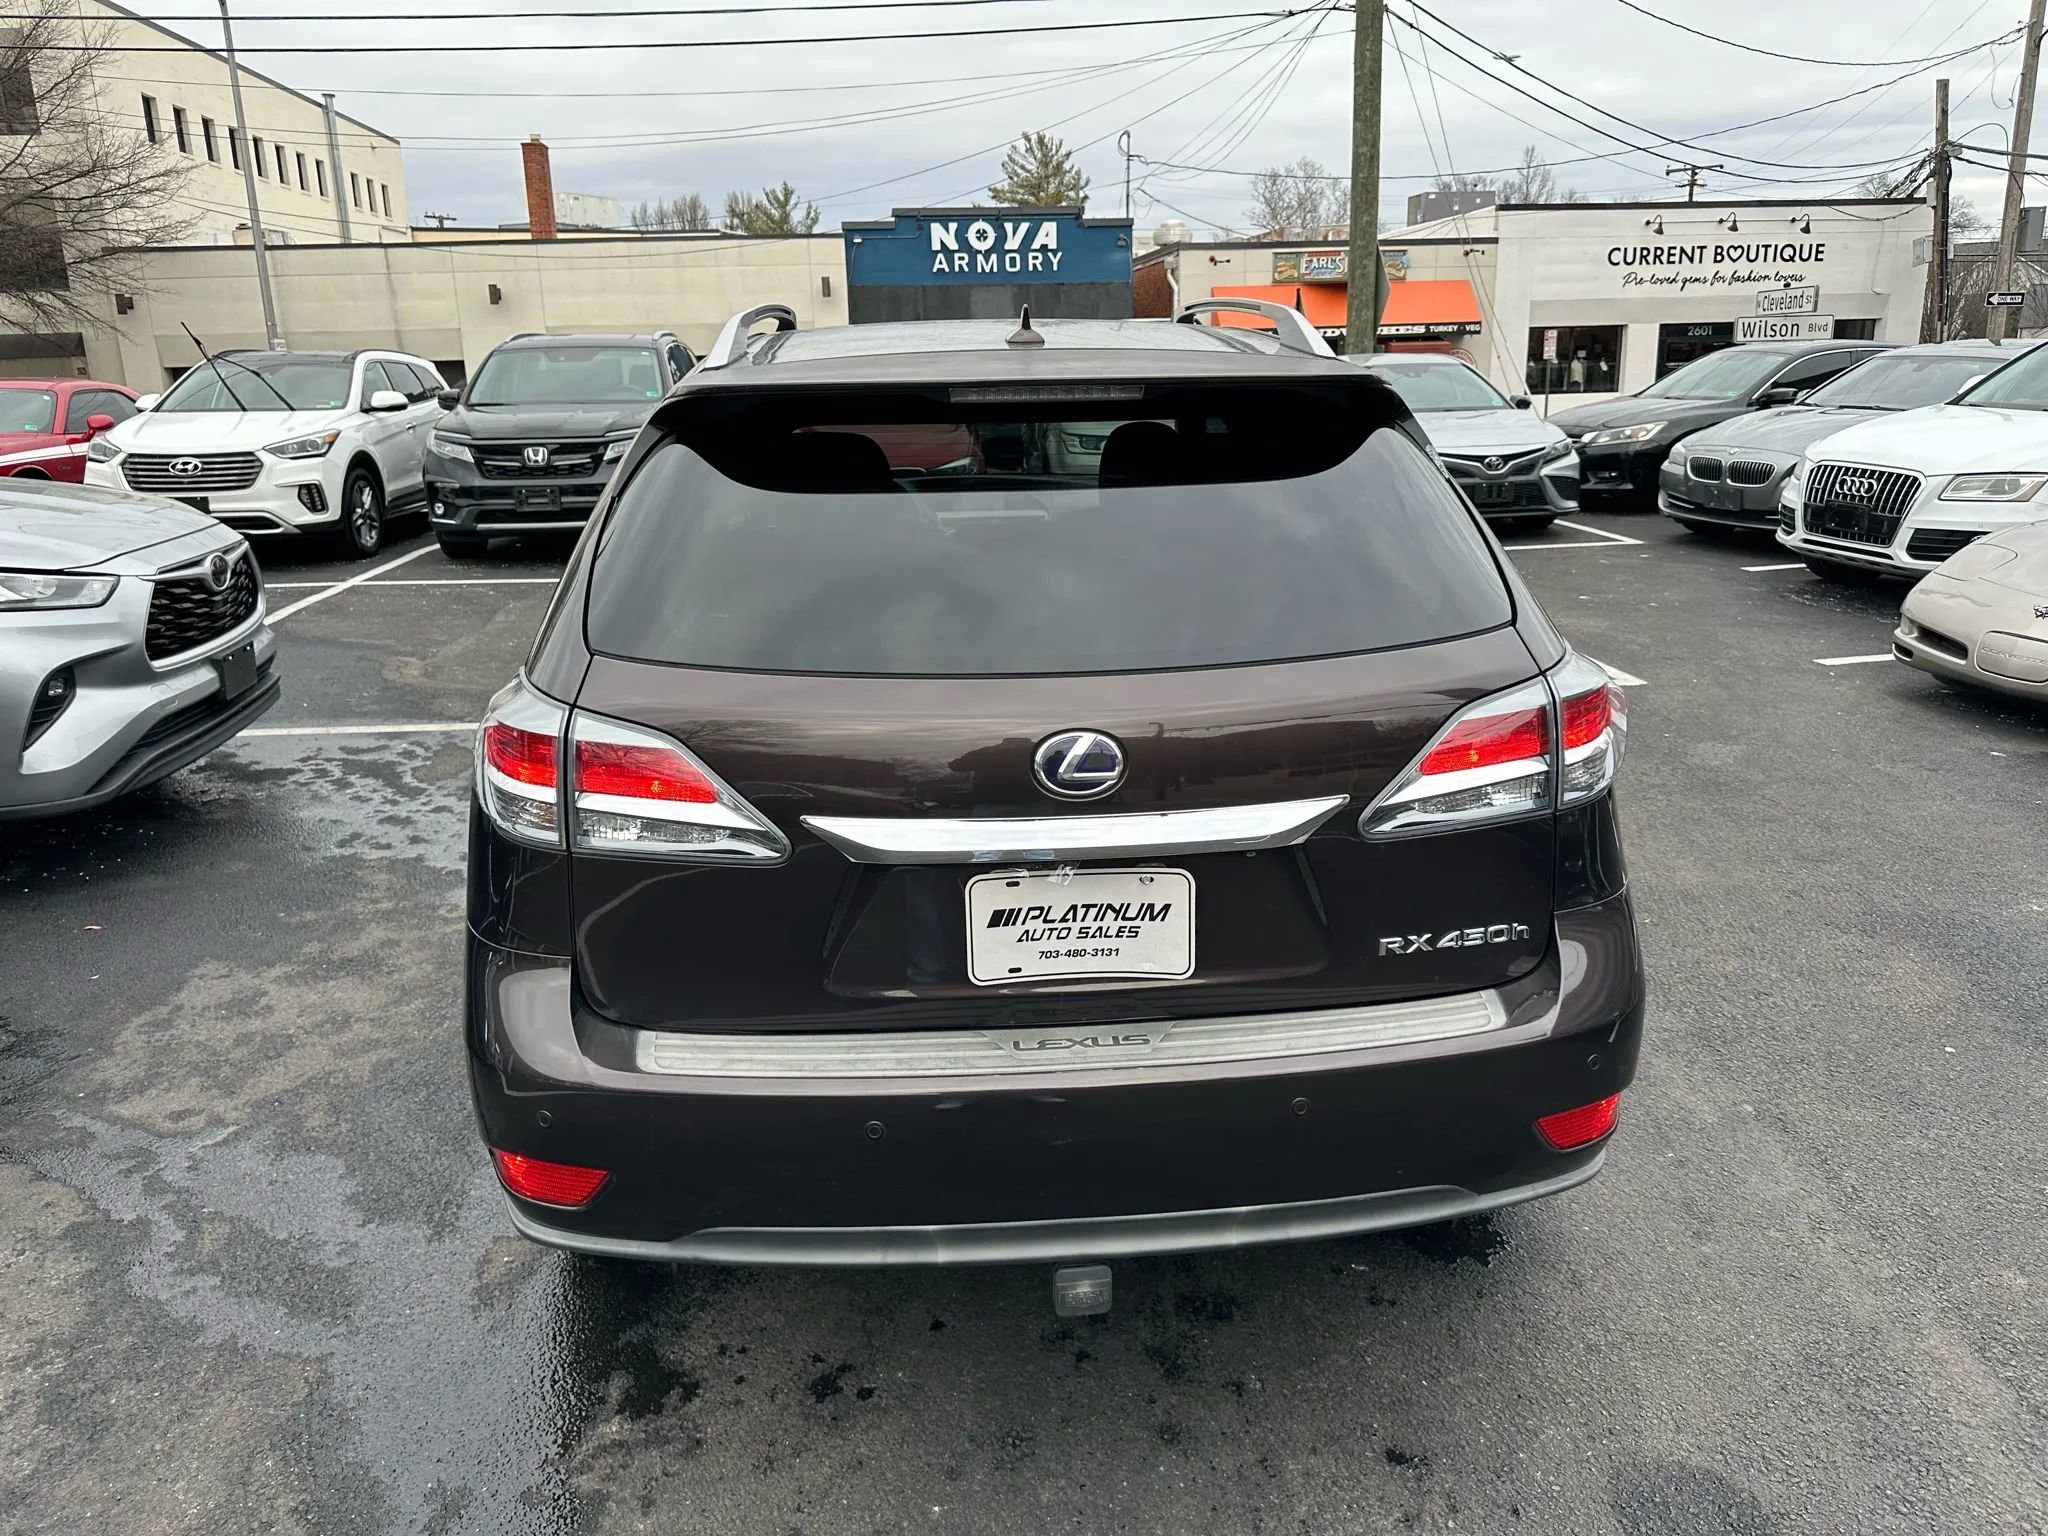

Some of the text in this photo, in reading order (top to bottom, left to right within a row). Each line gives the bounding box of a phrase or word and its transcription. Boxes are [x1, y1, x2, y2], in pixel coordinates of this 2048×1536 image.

[930, 218, 1058, 253] NOVA
[932, 251, 1063, 273] ARMORY
[1303, 256, 1344, 273] EARL'S
[1607, 243, 1825, 266] CURRENT BOUTIQUE
[1622, 270, 1806, 292] Pre-loved gems for fashion lovers
[1762, 290, 1804, 313] Cleveland
[1804, 294, 1813, 305] St
[1687, 325, 1712, 336] 2601
[1742, 320, 1829, 338] Wilson Blvd
[1021, 902, 1172, 926] PLATINUM
[1016, 925, 1142, 943] AUTO SALES
[1378, 922, 1530, 957] RX 450h
[1038, 948, 1120, 960] 703-480-3131
[1012, 1034, 1151, 1052] LEXUS
